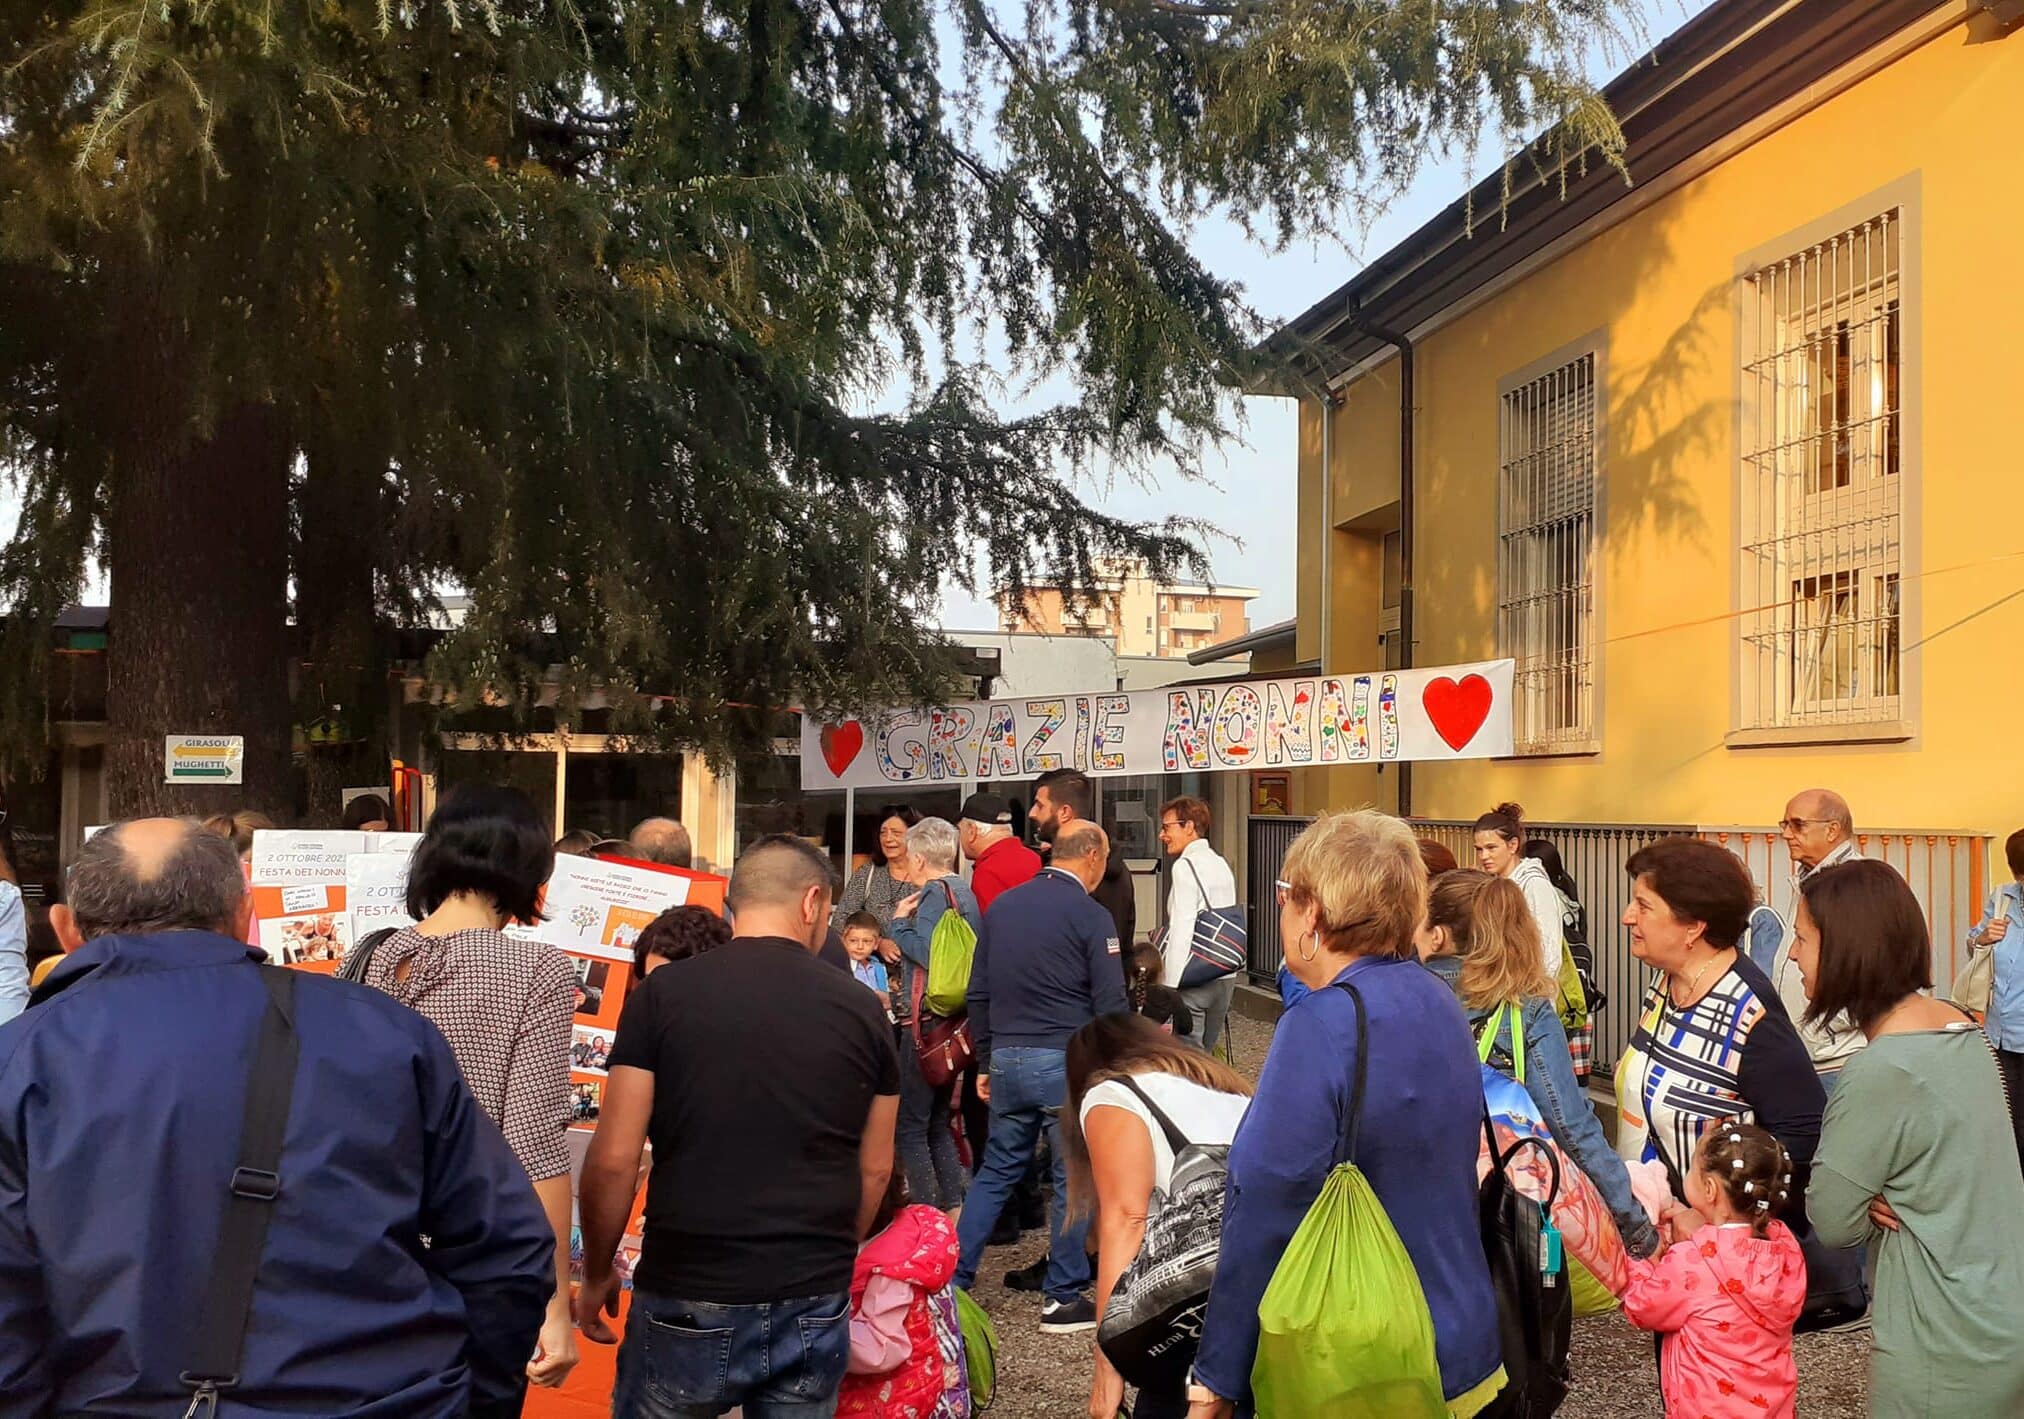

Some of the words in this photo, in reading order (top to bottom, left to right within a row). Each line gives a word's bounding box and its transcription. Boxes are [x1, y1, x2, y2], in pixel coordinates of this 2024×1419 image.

[875, 695, 1129, 782] GRAZIE
[1163, 674, 1399, 771] NONNI
[185, 739, 230, 747] GIRASOLI
[174, 760, 225, 768] MUGHETTI
[267, 854, 273, 862] 2
[276, 854, 323, 863] OTTOBRE
[259, 867, 292, 876] FESTA
[295, 867, 312, 876] DEI
[315, 867, 346, 876] NONN
[366, 886, 375, 897] 2
[356, 905, 399, 917] FESTA
[1147, 1332, 1185, 1357] RUTH
